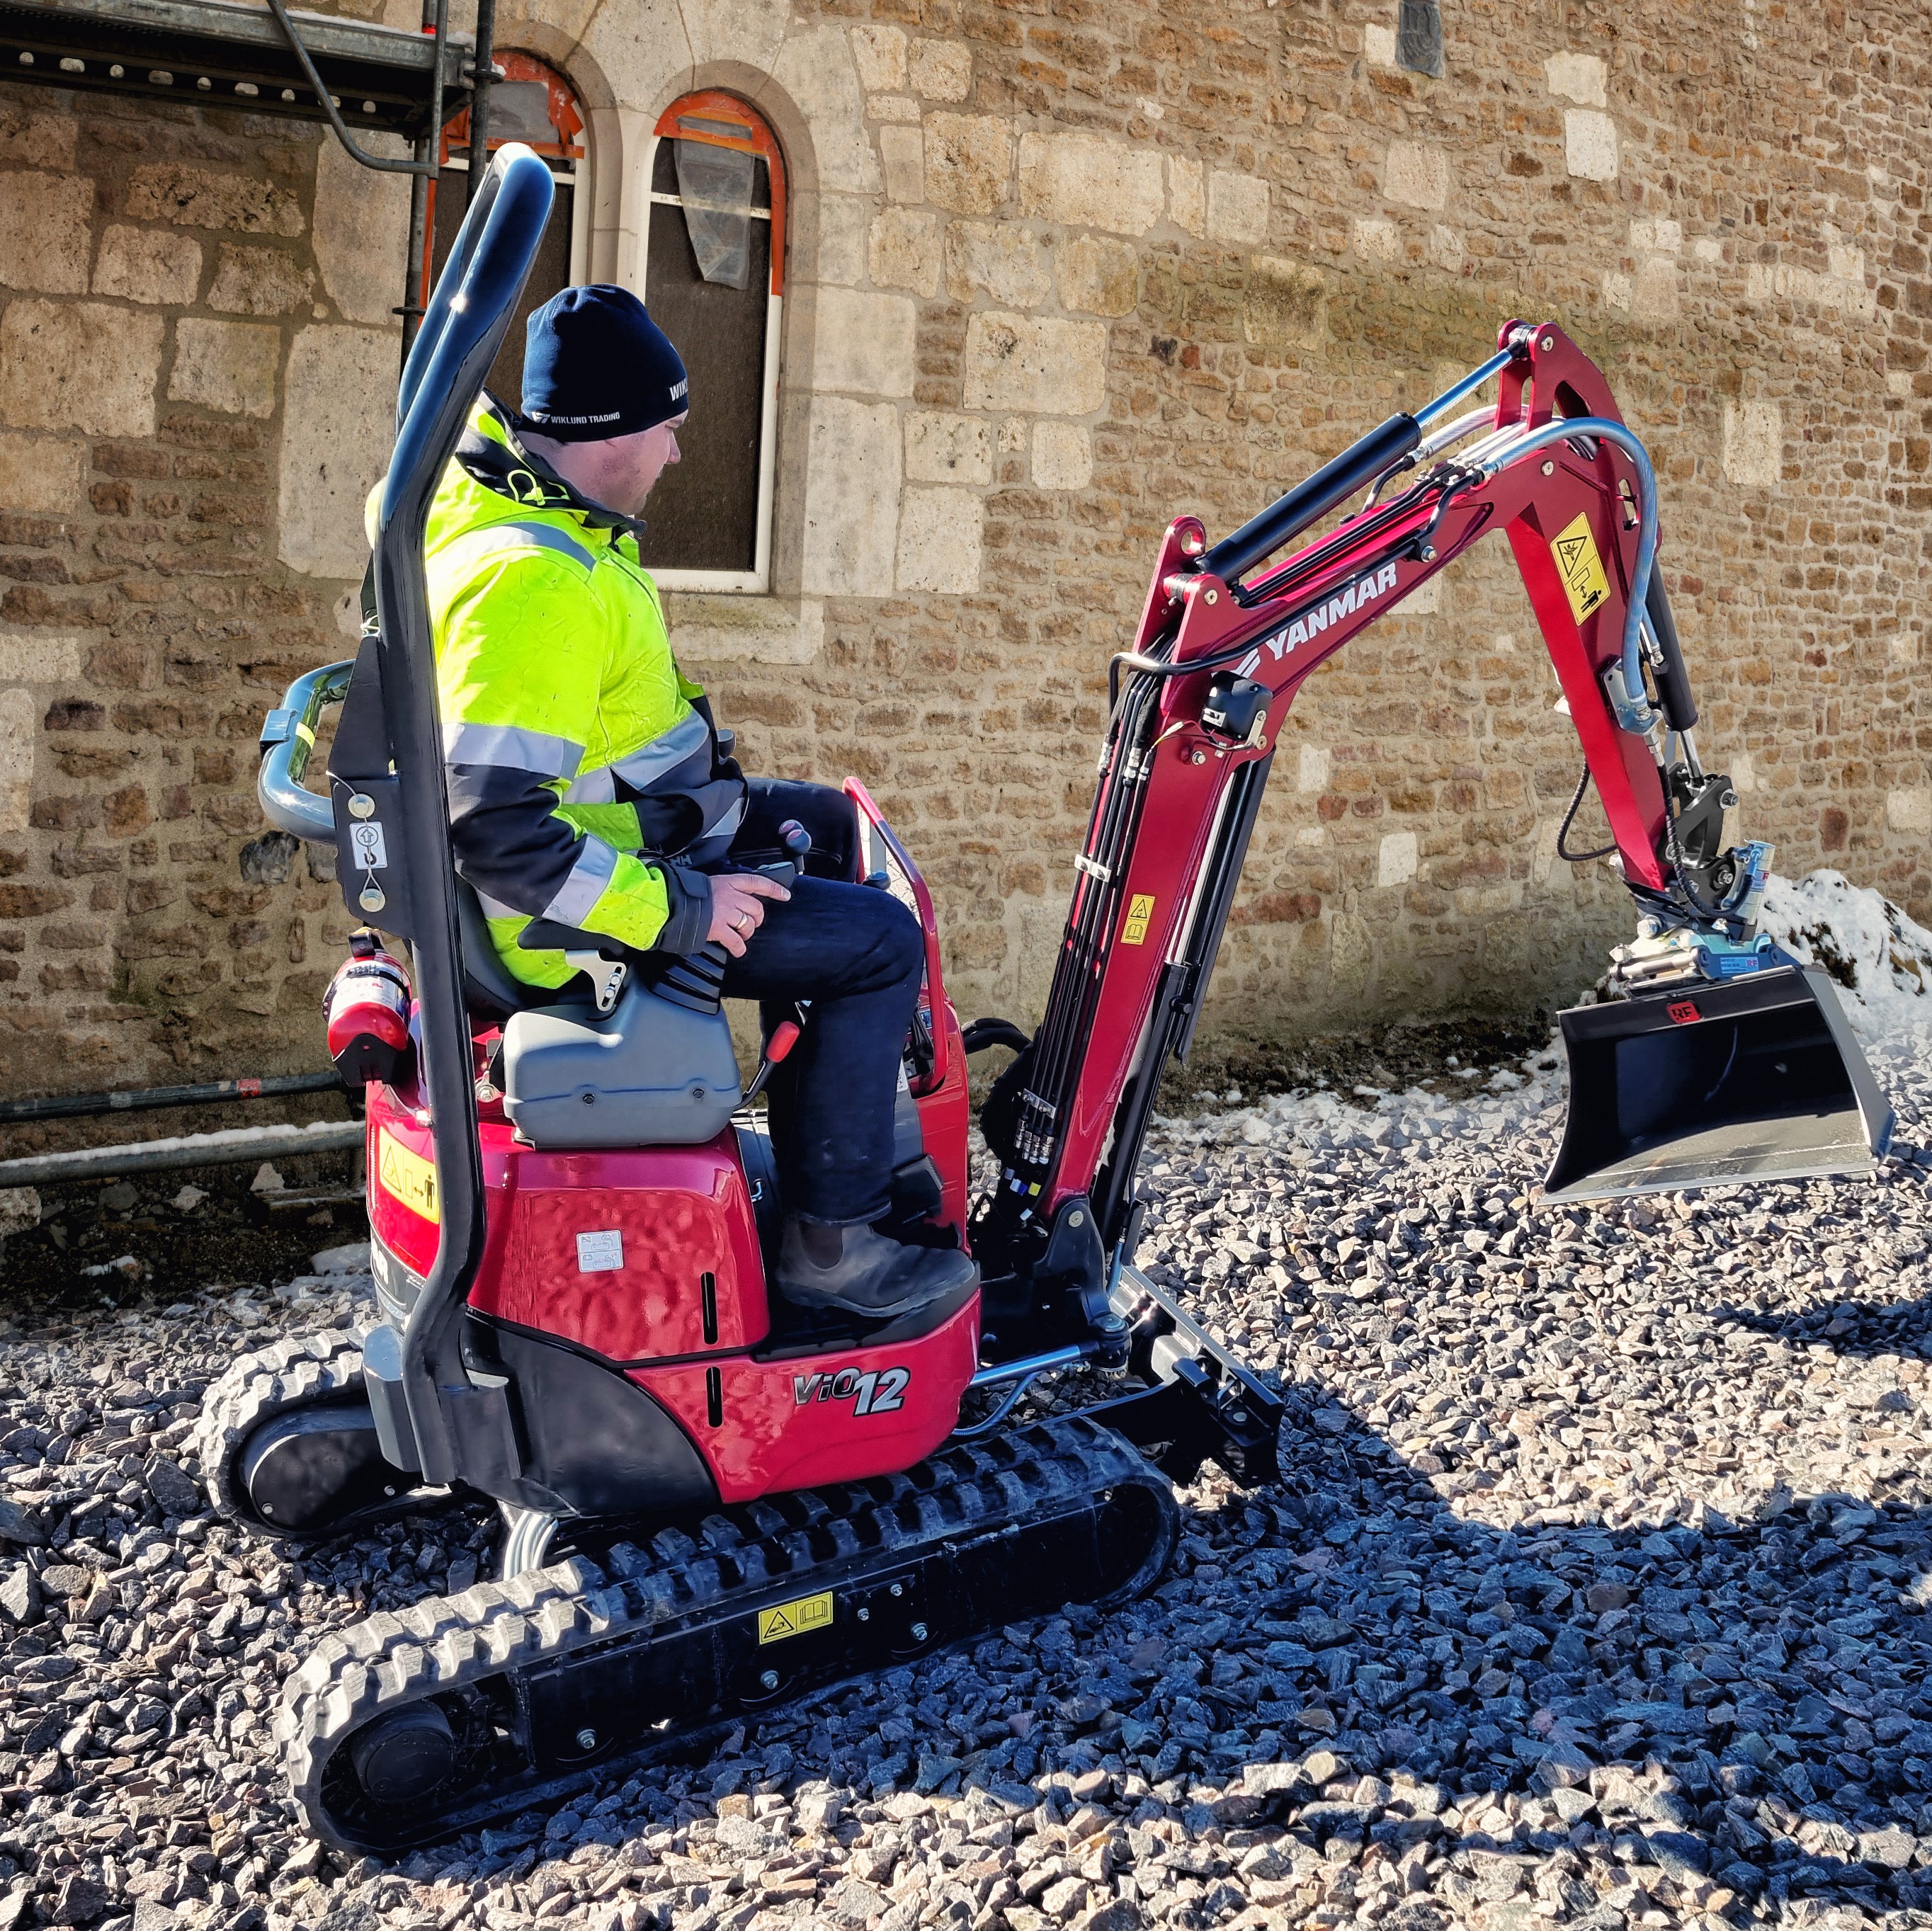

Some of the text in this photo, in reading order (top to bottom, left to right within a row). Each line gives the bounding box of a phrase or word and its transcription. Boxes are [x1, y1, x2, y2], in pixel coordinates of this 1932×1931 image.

[551, 416, 587, 425] WIKLUND
[1265, 562, 1397, 661] YANMAR
[1671, 1006, 1692, 1020] RF
